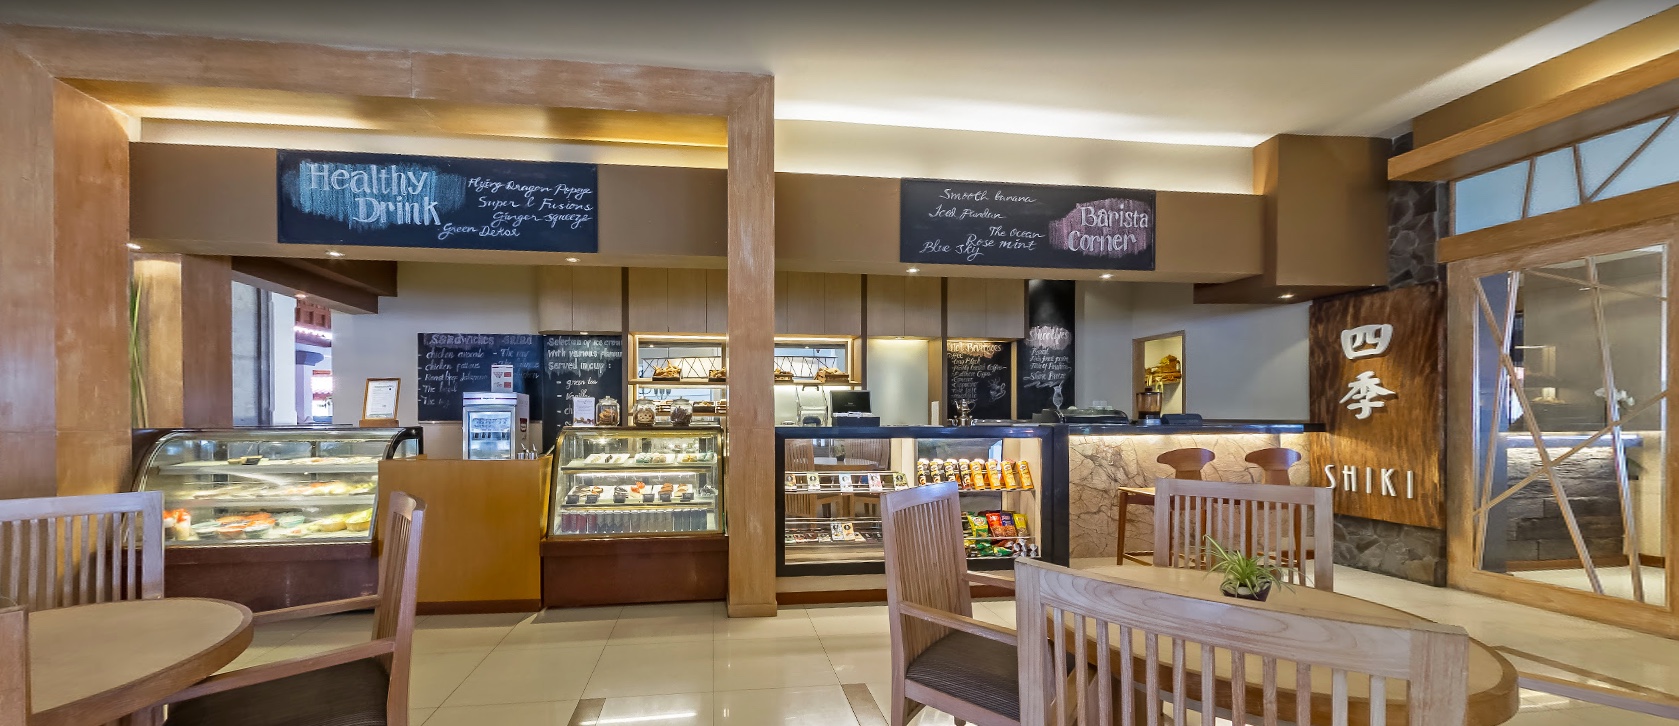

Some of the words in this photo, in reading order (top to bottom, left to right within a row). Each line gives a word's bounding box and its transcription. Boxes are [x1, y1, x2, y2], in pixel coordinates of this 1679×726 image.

[308, 163, 428, 195] Healthy
[505, 180, 551, 197] Dragon
[939, 188, 989, 201] Smooth
[995, 190, 1037, 203] banana
[352, 196, 441, 226] Drink
[478, 196, 520, 210] Super
[539, 198, 593, 211] Fusions
[929, 203, 956, 218] Iced
[1080, 203, 1148, 228] Barista
[438, 222, 477, 240] Green
[989, 225, 1006, 237] The
[919, 239, 951, 253] Blue
[965, 233, 995, 248] Rose
[999, 239, 1037, 251] mint
[1067, 230, 1137, 252] Corner
[1339, 323, 1397, 420] 四季
[1324, 464, 1414, 499] SHIKI
